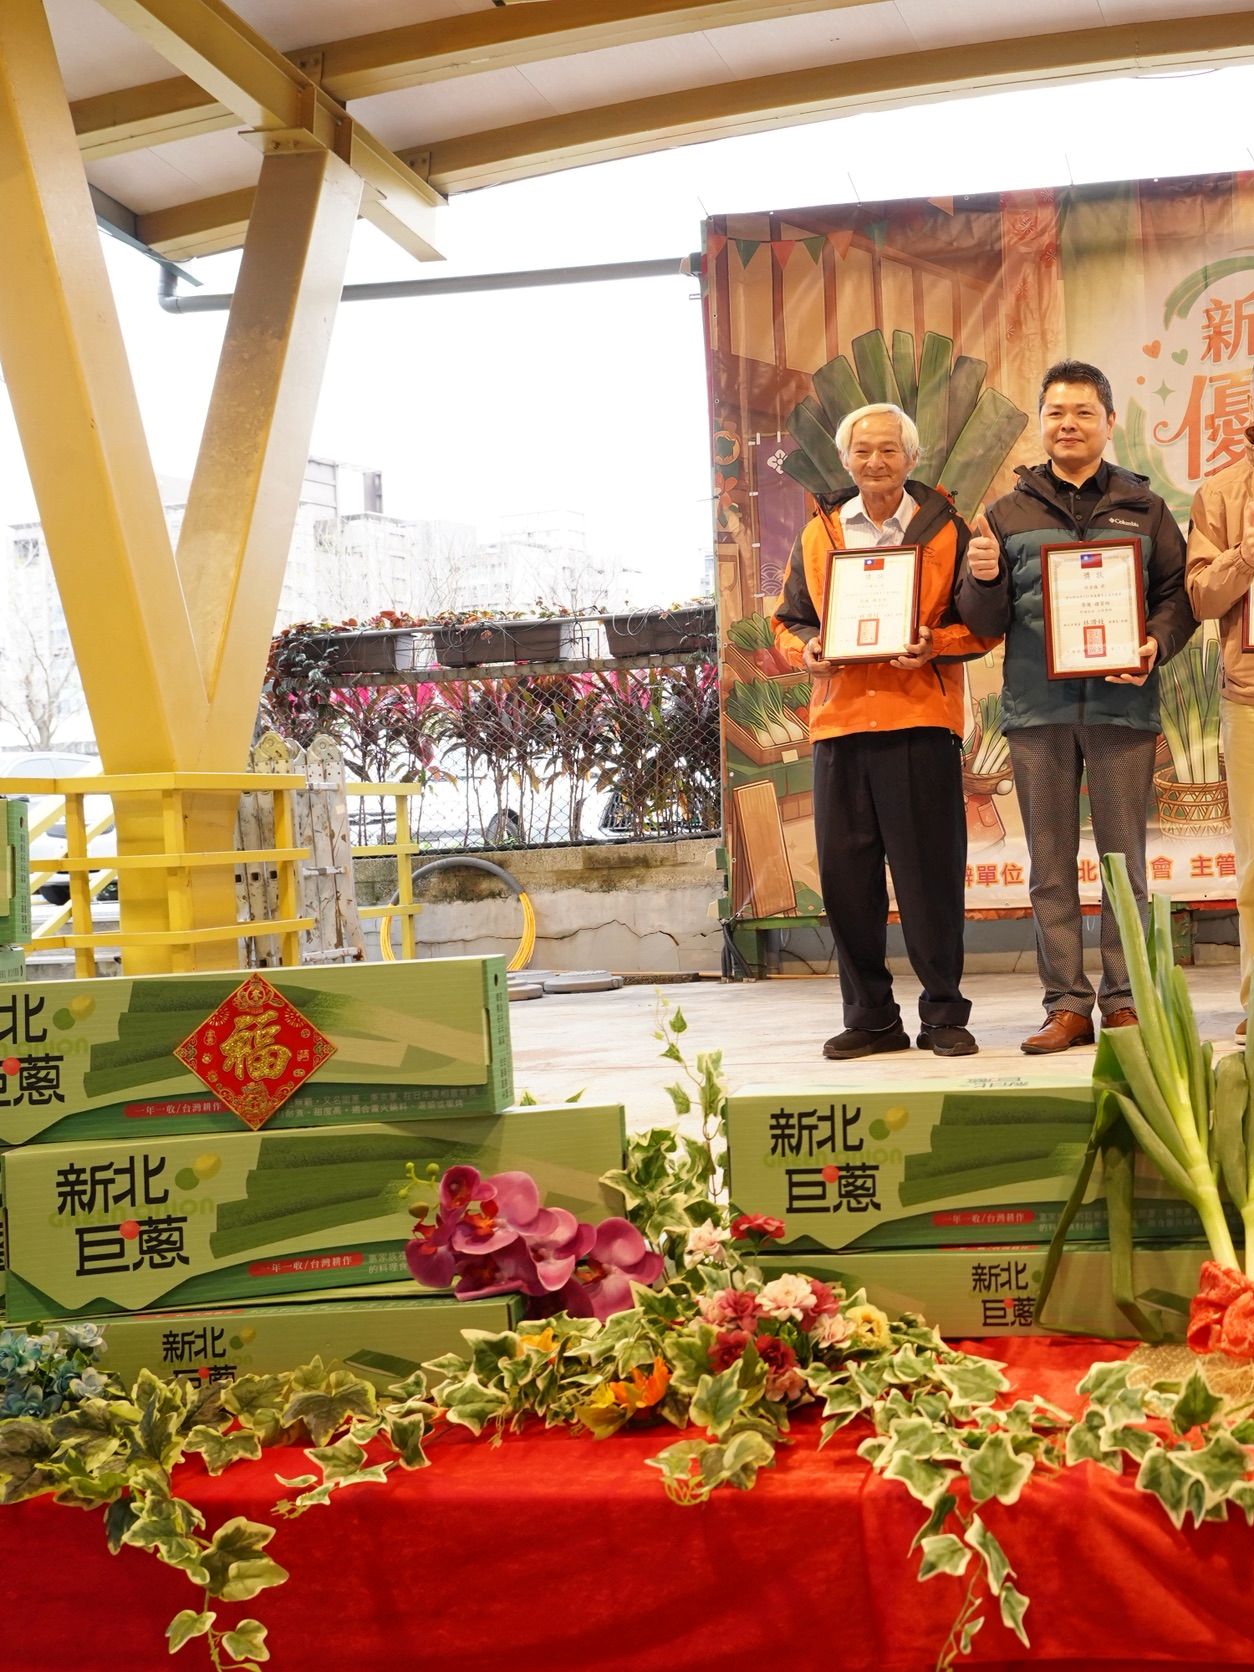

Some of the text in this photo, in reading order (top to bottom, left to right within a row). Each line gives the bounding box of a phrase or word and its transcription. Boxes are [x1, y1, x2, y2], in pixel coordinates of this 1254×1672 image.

[220, 1009, 292, 1081] 福
[0, 1052, 65, 1107] 蔥
[769, 1104, 864, 1157] 新北
[56, 1154, 169, 1216] 新北
[785, 1162, 881, 1214] 巨蔥
[75, 1214, 190, 1277] 巨蔥
[972, 1261, 1029, 1293] 新北
[981, 1296, 1036, 1327] 巨蔥
[162, 1326, 226, 1363] 新北
